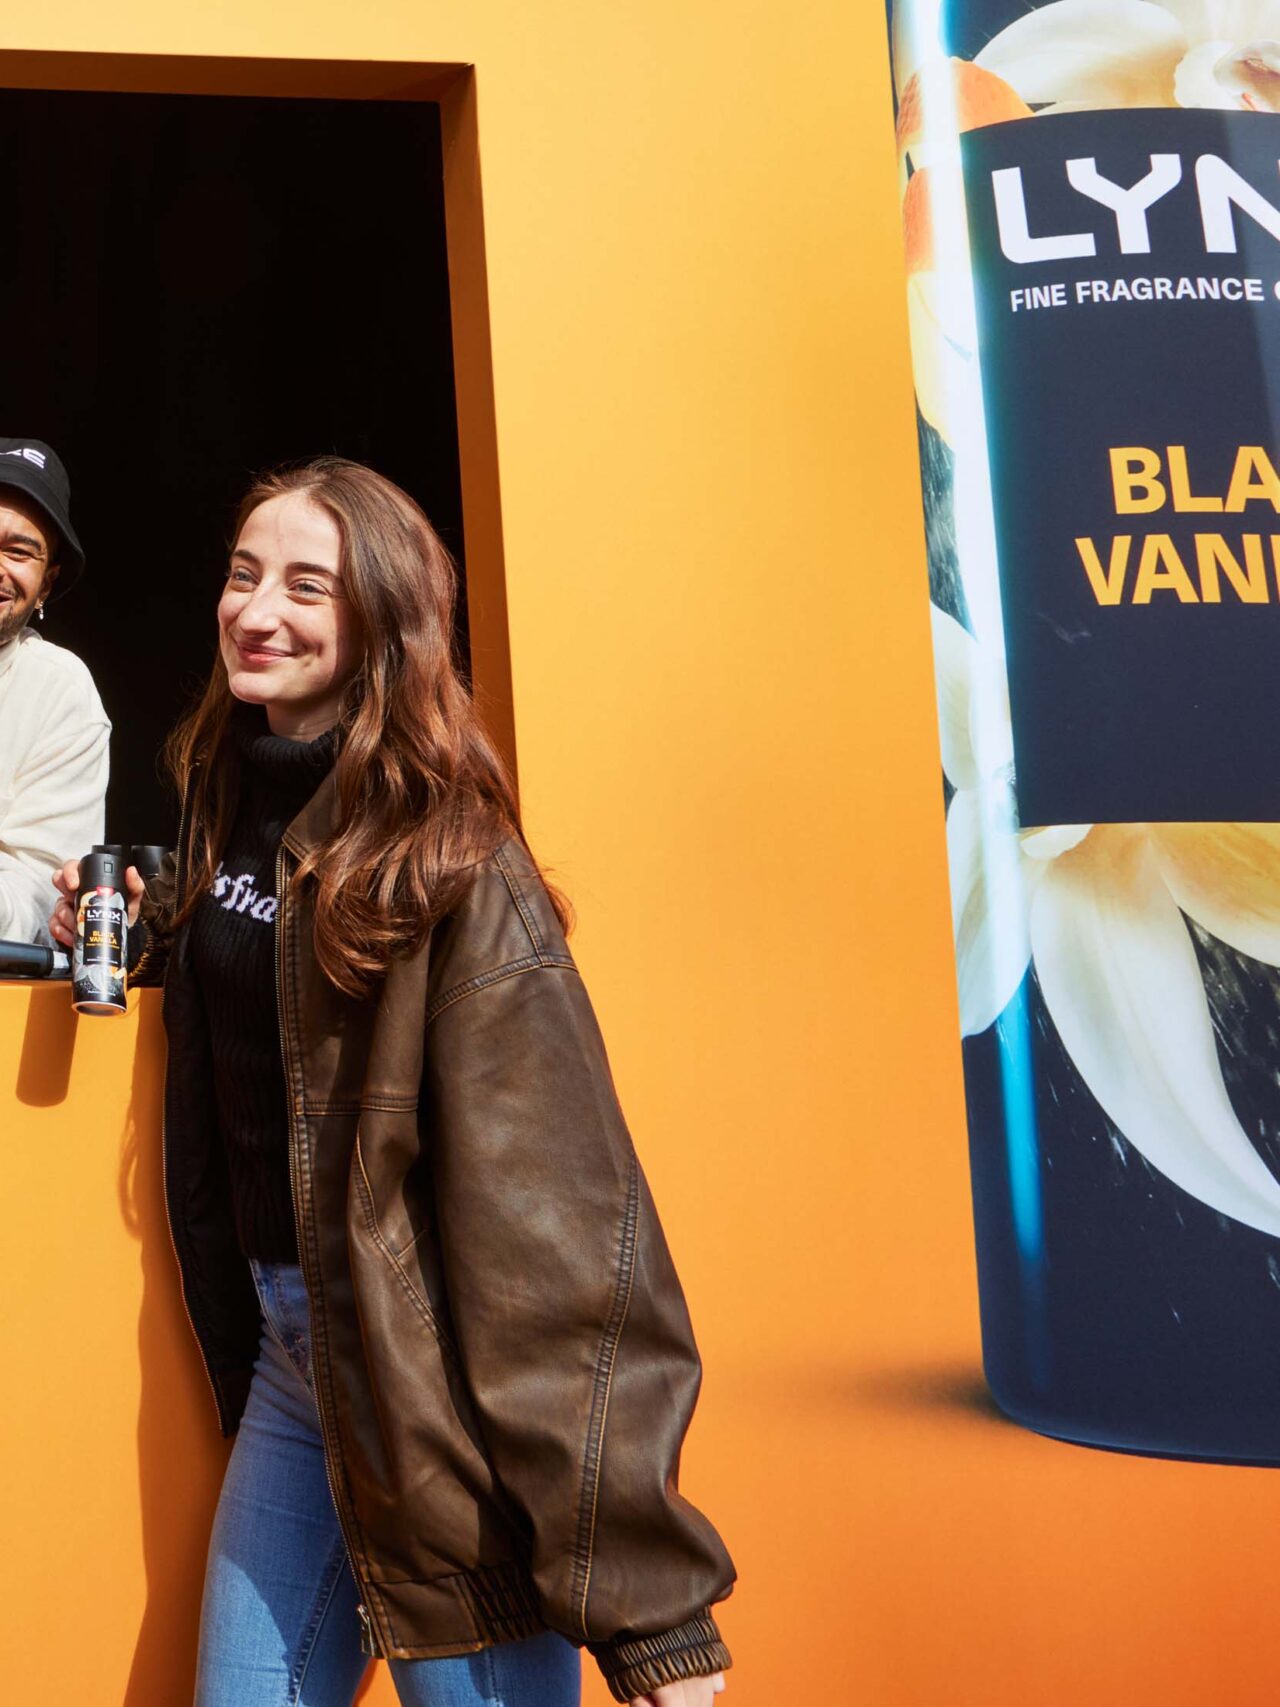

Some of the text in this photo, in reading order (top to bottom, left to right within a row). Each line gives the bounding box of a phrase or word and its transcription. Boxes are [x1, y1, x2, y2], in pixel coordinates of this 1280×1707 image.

[1009, 283, 1068, 312] FINE
[1075, 276, 1266, 305] FRAGRANCE
[1108, 445, 1280, 515] BLA
